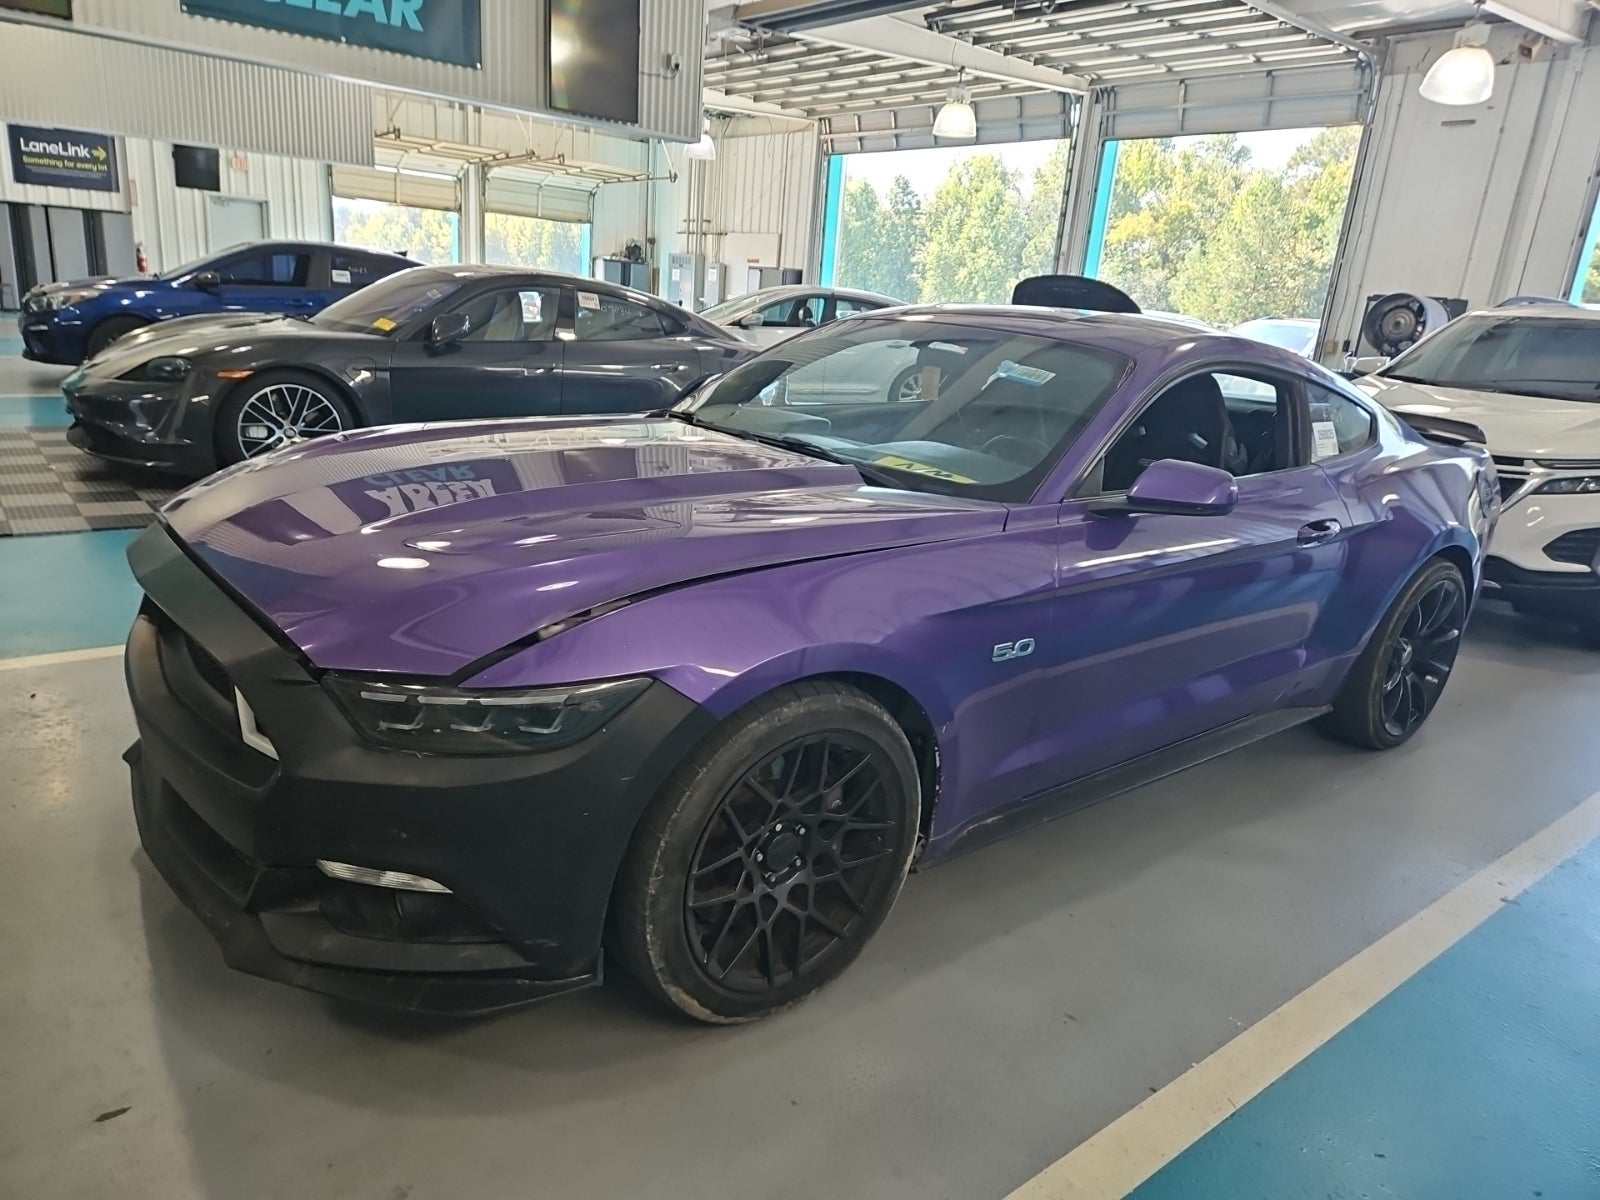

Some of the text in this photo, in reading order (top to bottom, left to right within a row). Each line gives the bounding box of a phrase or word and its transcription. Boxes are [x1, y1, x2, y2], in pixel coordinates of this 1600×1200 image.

[20, 137, 91, 158] LaneLink
[22, 155, 63, 168] Something
[64, 159, 75, 168] for
[76, 162, 97, 171] every
[992, 638, 1035, 662] 5.0
